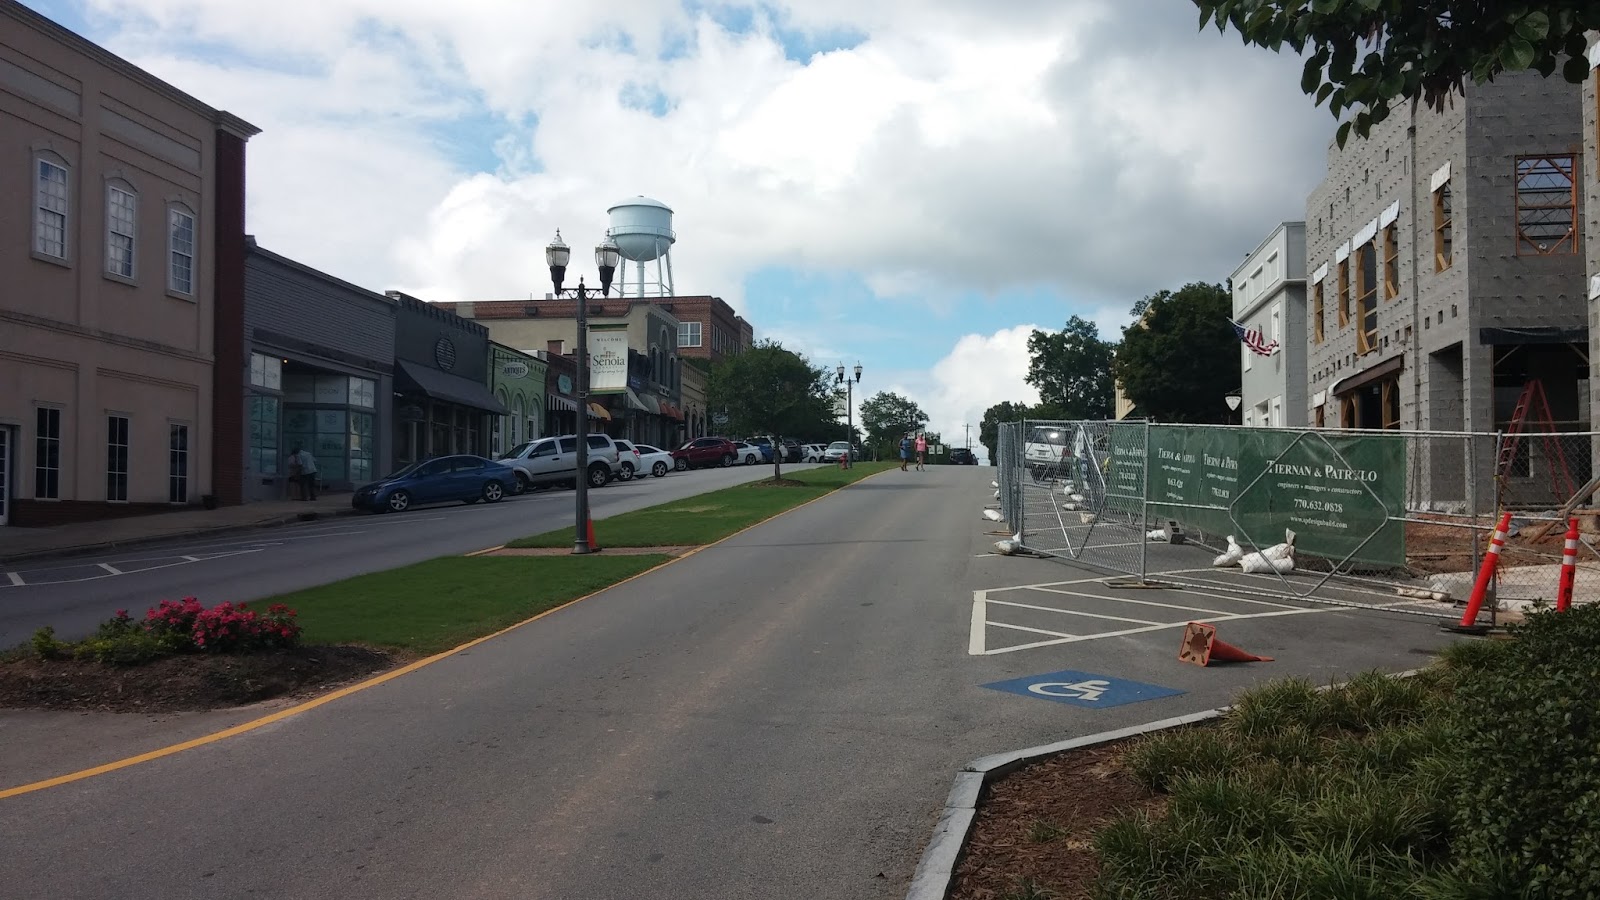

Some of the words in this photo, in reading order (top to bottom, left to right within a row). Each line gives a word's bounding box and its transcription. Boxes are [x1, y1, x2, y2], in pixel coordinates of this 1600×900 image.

[593, 355, 625, 366] Senoia
[1266, 460, 1312, 477] TIERNAN
[1314, 467, 1322, 477] &
[1277, 481, 1299, 489] engineers
[1304, 484, 1326, 492] managers
[1331, 487, 1363, 495] constructors
[1294, 498, 1343, 513] 770.632.0828
